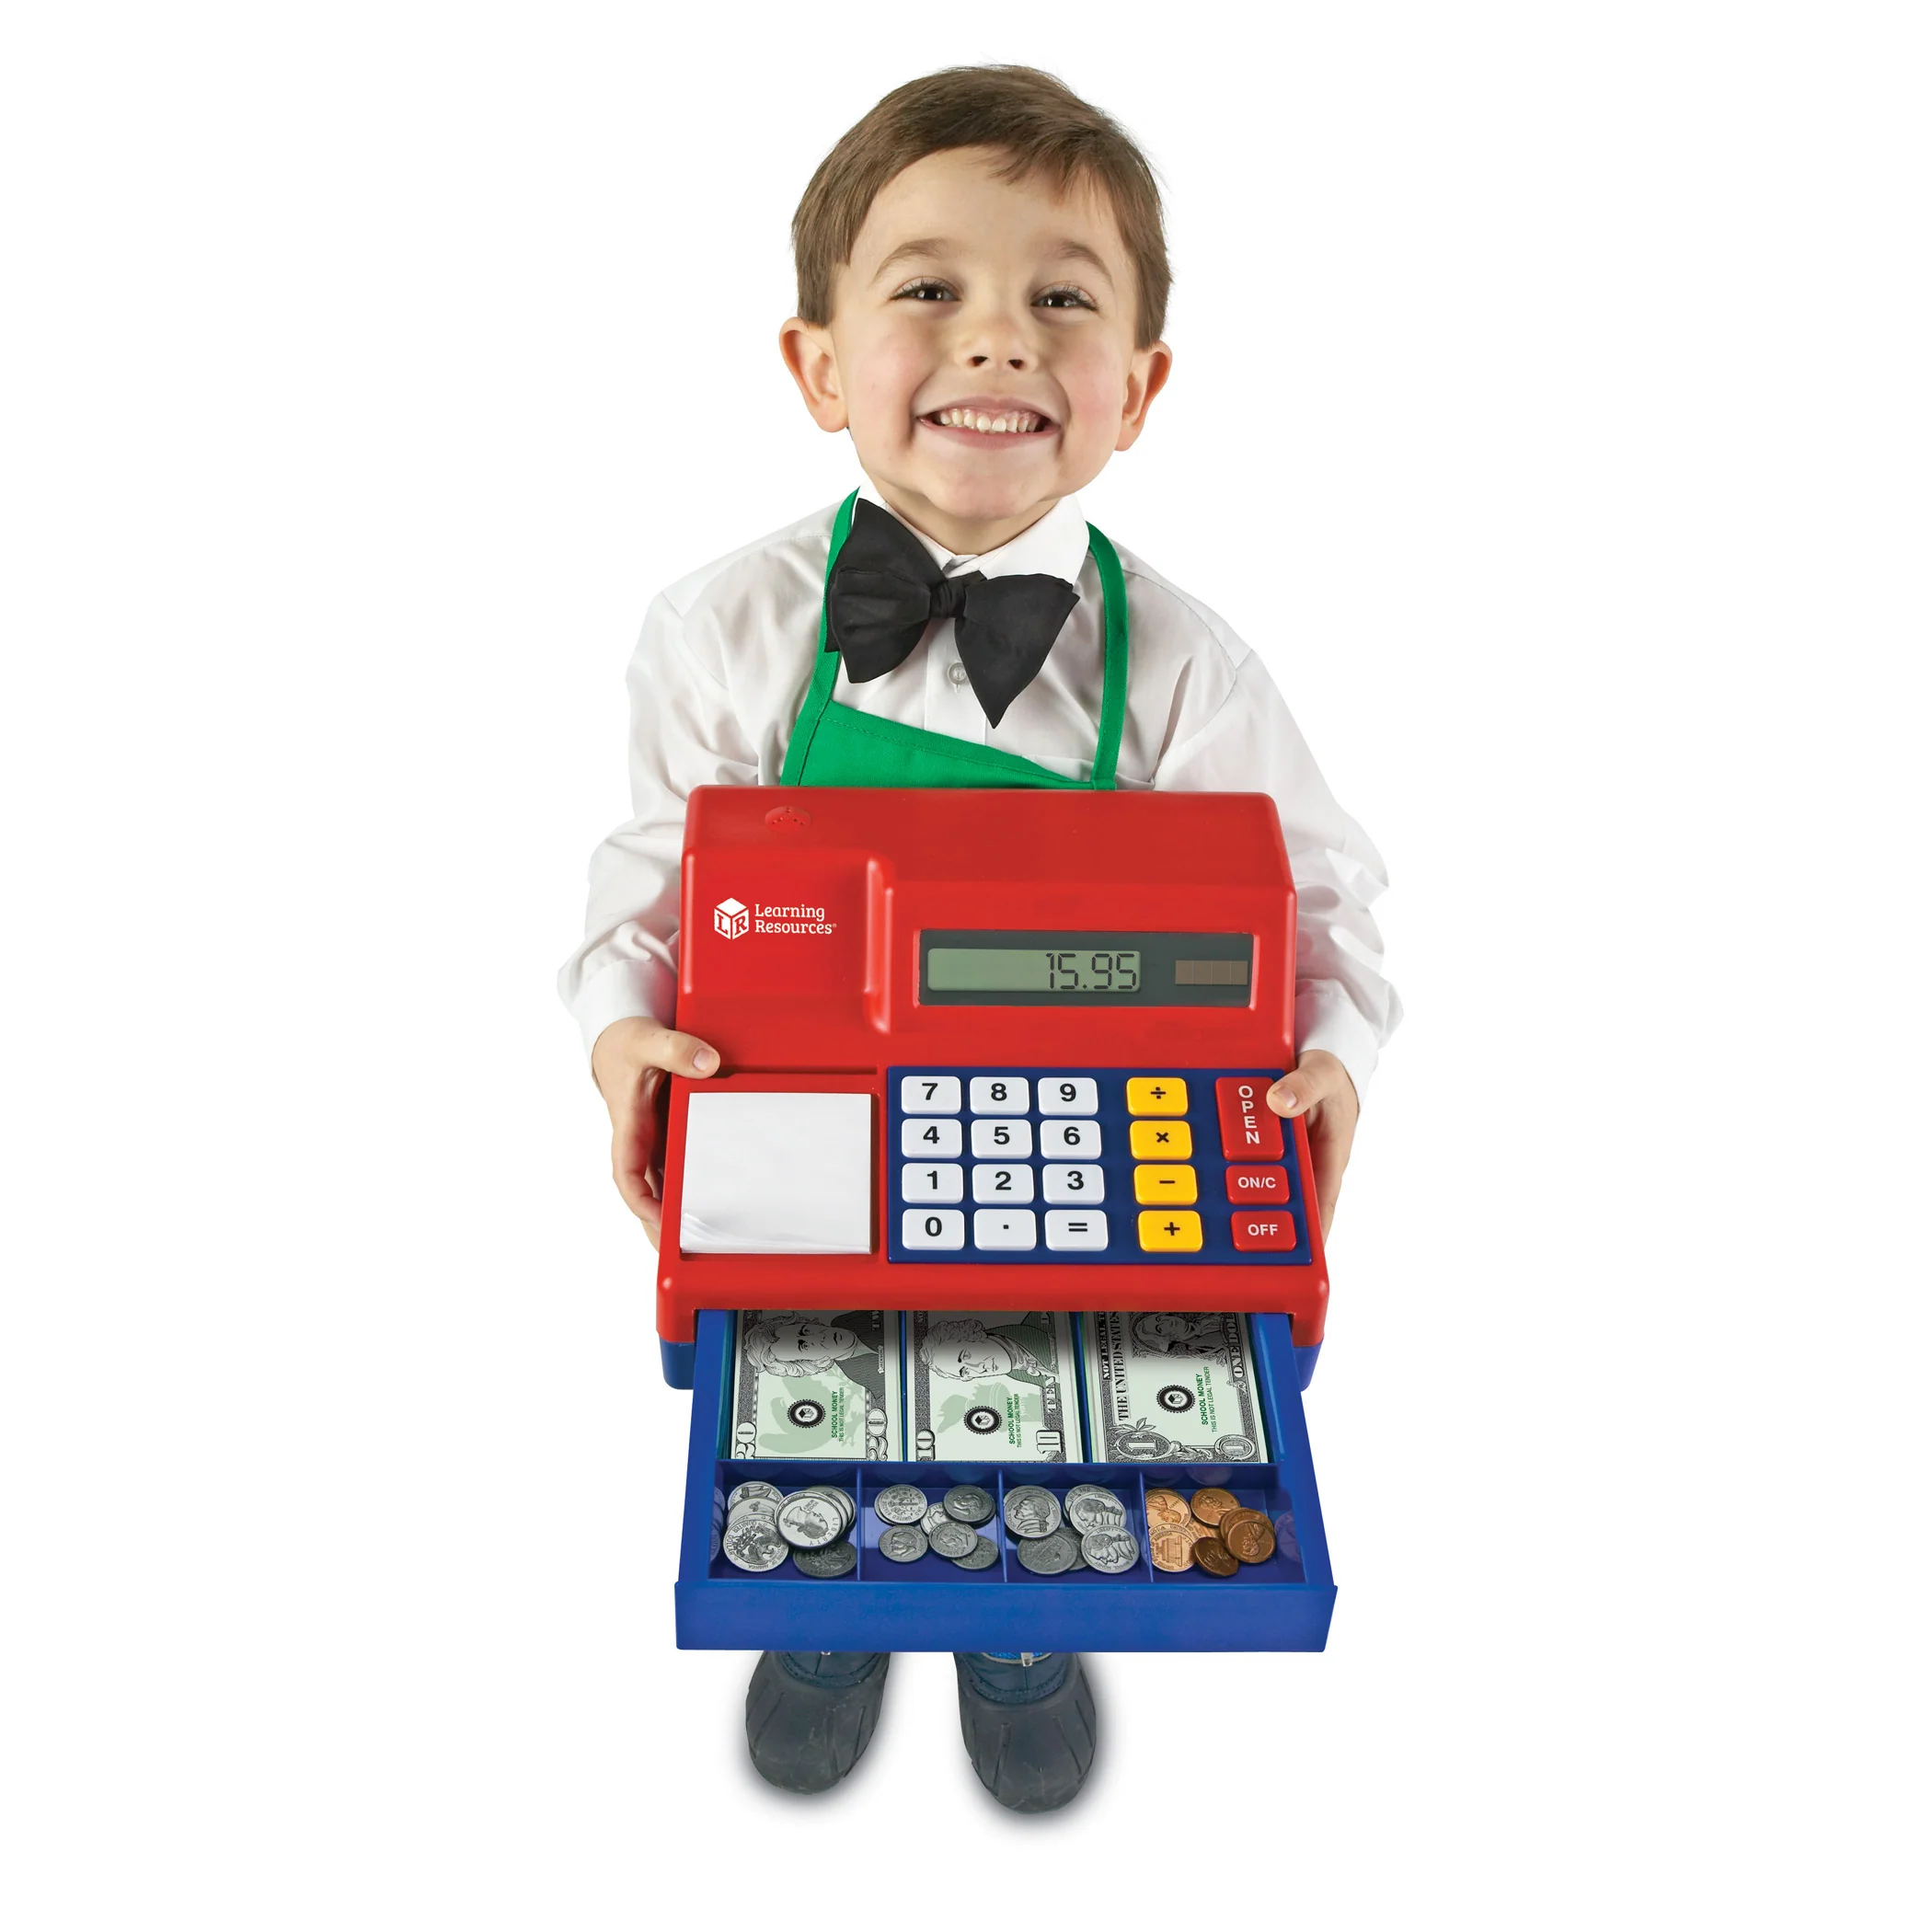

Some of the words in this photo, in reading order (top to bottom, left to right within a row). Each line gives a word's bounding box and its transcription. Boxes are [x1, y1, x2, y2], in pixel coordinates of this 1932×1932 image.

[754, 903, 825, 922] Learning
[754, 919, 833, 936] Resources
[1045, 952, 1137, 990] 15.95
[922, 1083, 937, 1100] 7
[991, 1083, 1006, 1101] 8
[1060, 1083, 1076, 1102] 9
[1238, 1085, 1260, 1144] OPEN
[923, 1126, 939, 1144] 4
[994, 1126, 1010, 1145] 5
[1064, 1126, 1080, 1145] 6
[927, 1170, 938, 1190] 1
[995, 1171, 1012, 1190] 2
[1067, 1170, 1085, 1190] 3
[1237, 1177, 1277, 1189] ON/C
[925, 1216, 943, 1237] 0
[1248, 1224, 1278, 1236] OFF
[1099, 1325, 1108, 1356] LEGAL
[1230, 1345, 1244, 1378] ONE
[1114, 1351, 1127, 1394] UNITED
[1203, 1366, 1212, 1386] TENDER
[1044, 1375, 1057, 1414] TEN
[1196, 1373, 1205, 1397] MONEY
[1206, 1386, 1214, 1403] LEGAL
[1118, 1396, 1130, 1421] THE
[1198, 1397, 1208, 1425] SCHOOL
[867, 1408, 889, 1461] 20
[1007, 1419, 1016, 1444] SCHOOL
[1210, 1420, 1218, 1433] THIS
[1035, 1429, 1064, 1455] 10
[809, 1516, 839, 1547] LIBERTY
